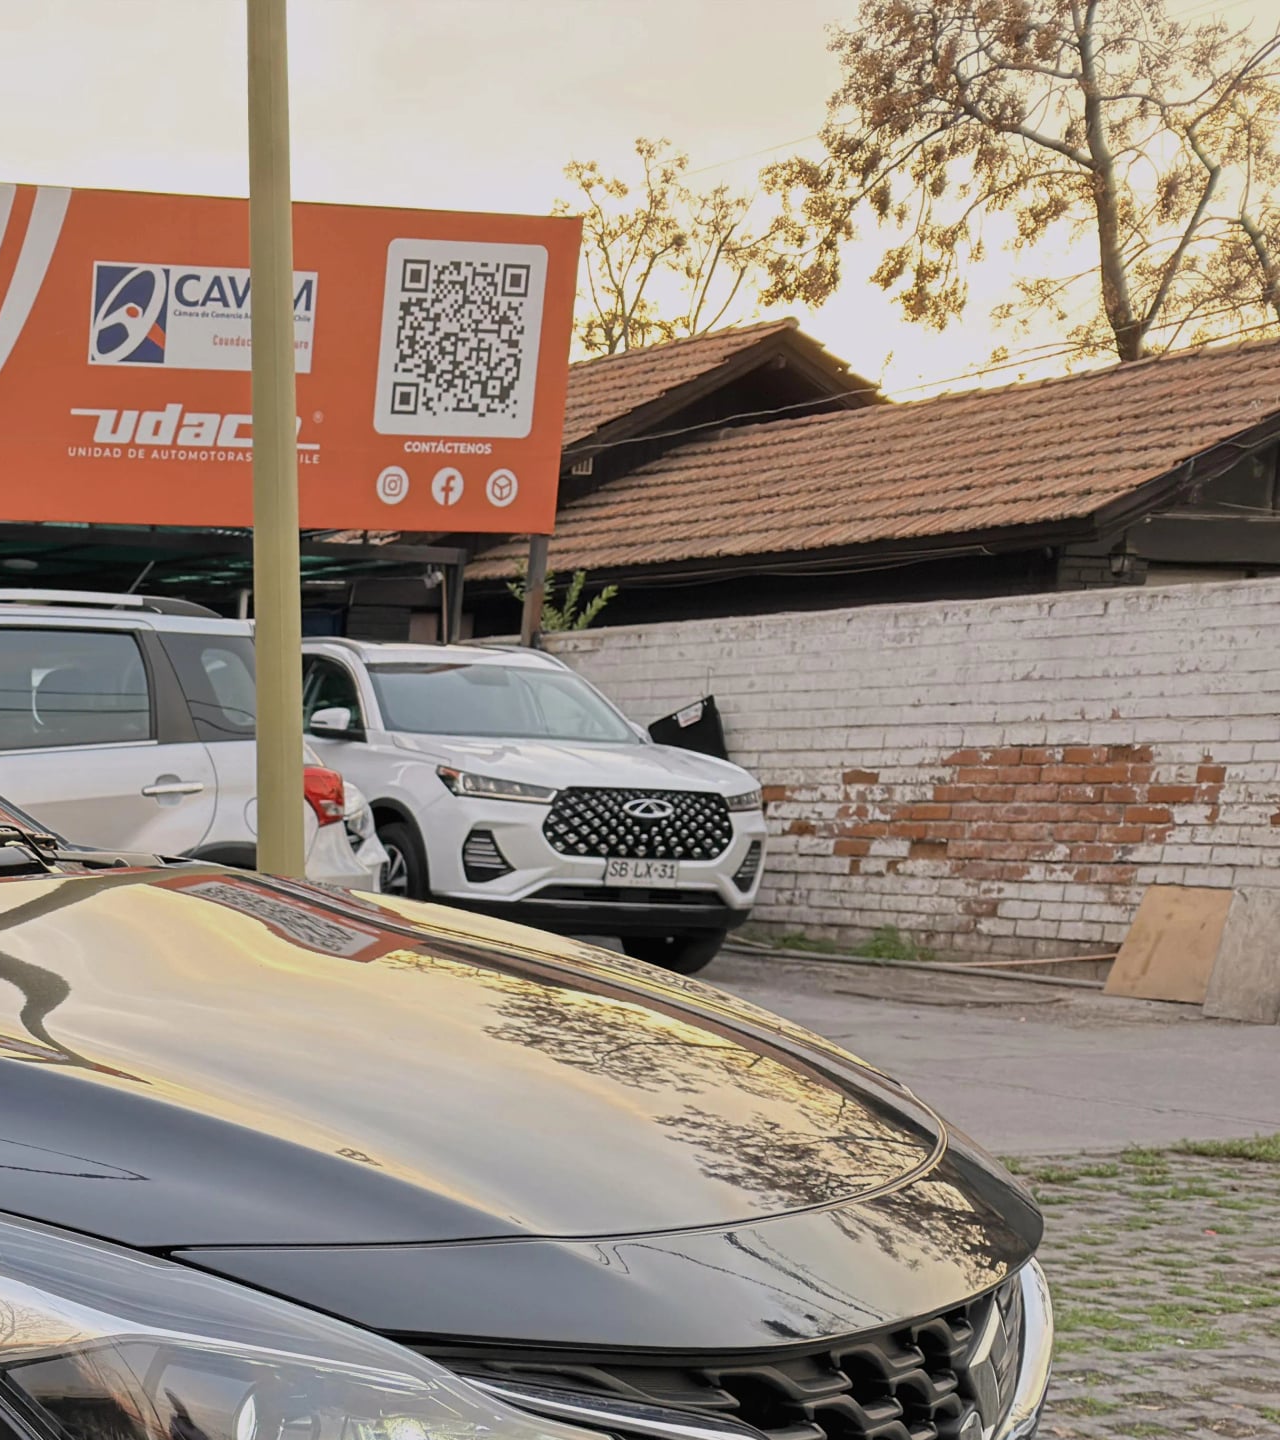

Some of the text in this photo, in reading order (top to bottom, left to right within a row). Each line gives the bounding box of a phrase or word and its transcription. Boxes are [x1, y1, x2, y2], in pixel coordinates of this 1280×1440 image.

[174, 273, 314, 311] CAVM
[67, 446, 122, 458] UNIDAD
[127, 447, 145, 460] DE
[150, 449, 253, 463] AUTOMOTORAS
[403, 439, 493, 455] CONTÁCTENOS
